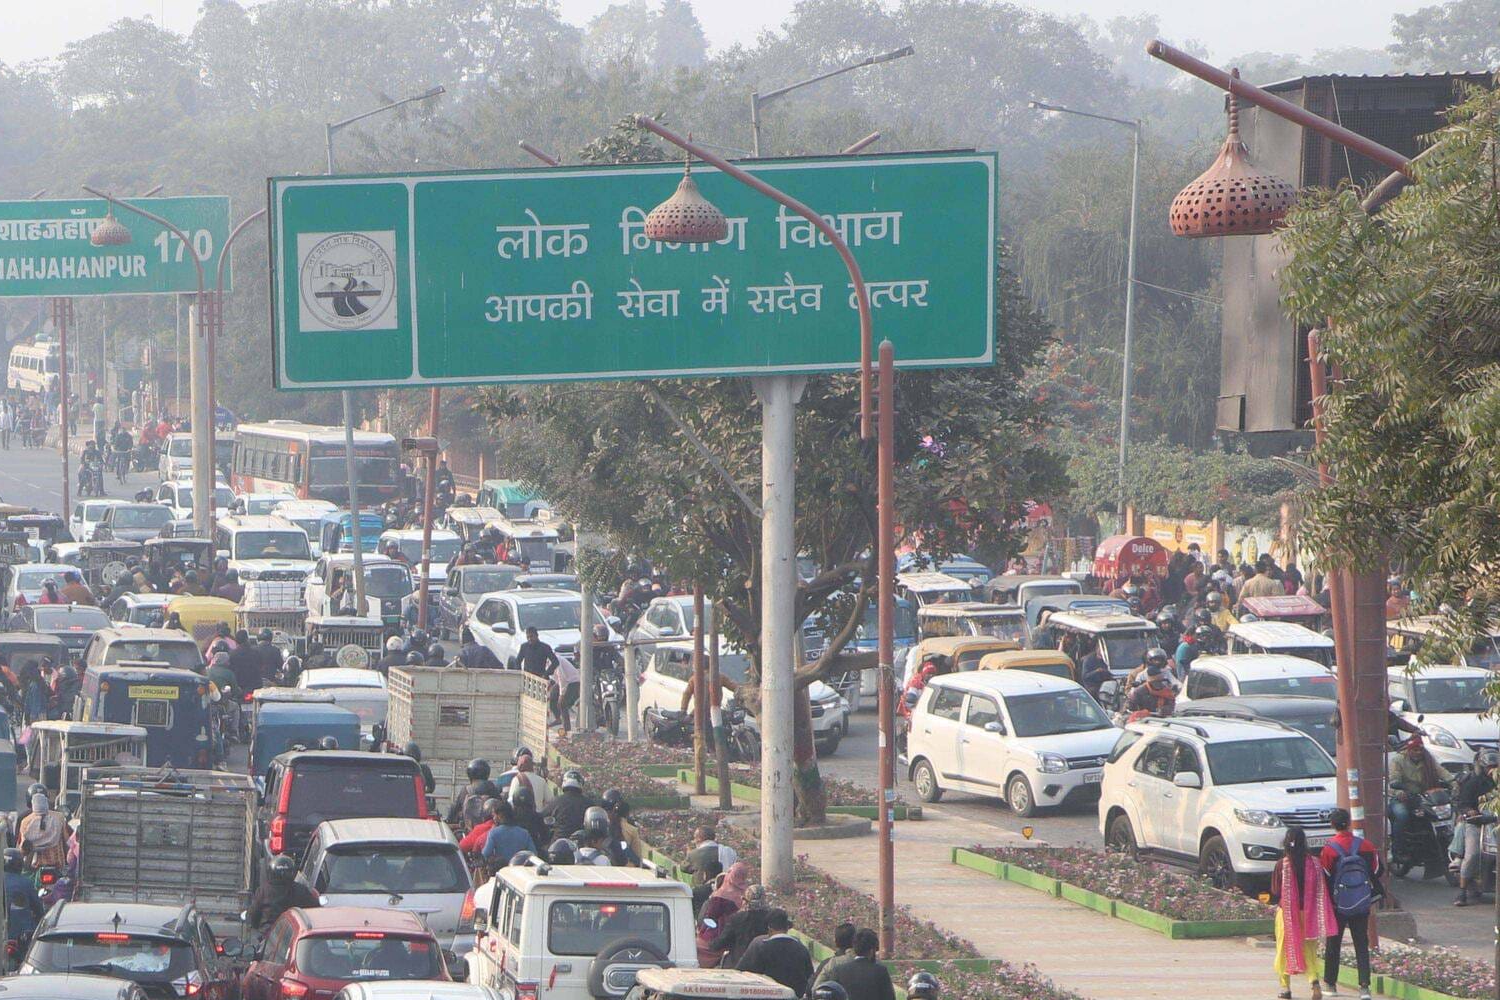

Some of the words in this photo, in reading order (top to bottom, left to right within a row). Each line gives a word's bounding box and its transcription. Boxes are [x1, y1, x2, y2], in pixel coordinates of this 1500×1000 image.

[154, 228, 213, 263] 170
[496, 208, 590, 259] लोक
[484, 280, 593, 323] आपकी
[617, 277, 680, 318] सेवा
[701, 275, 730, 314] में
[747, 272, 824, 314] सदैव
